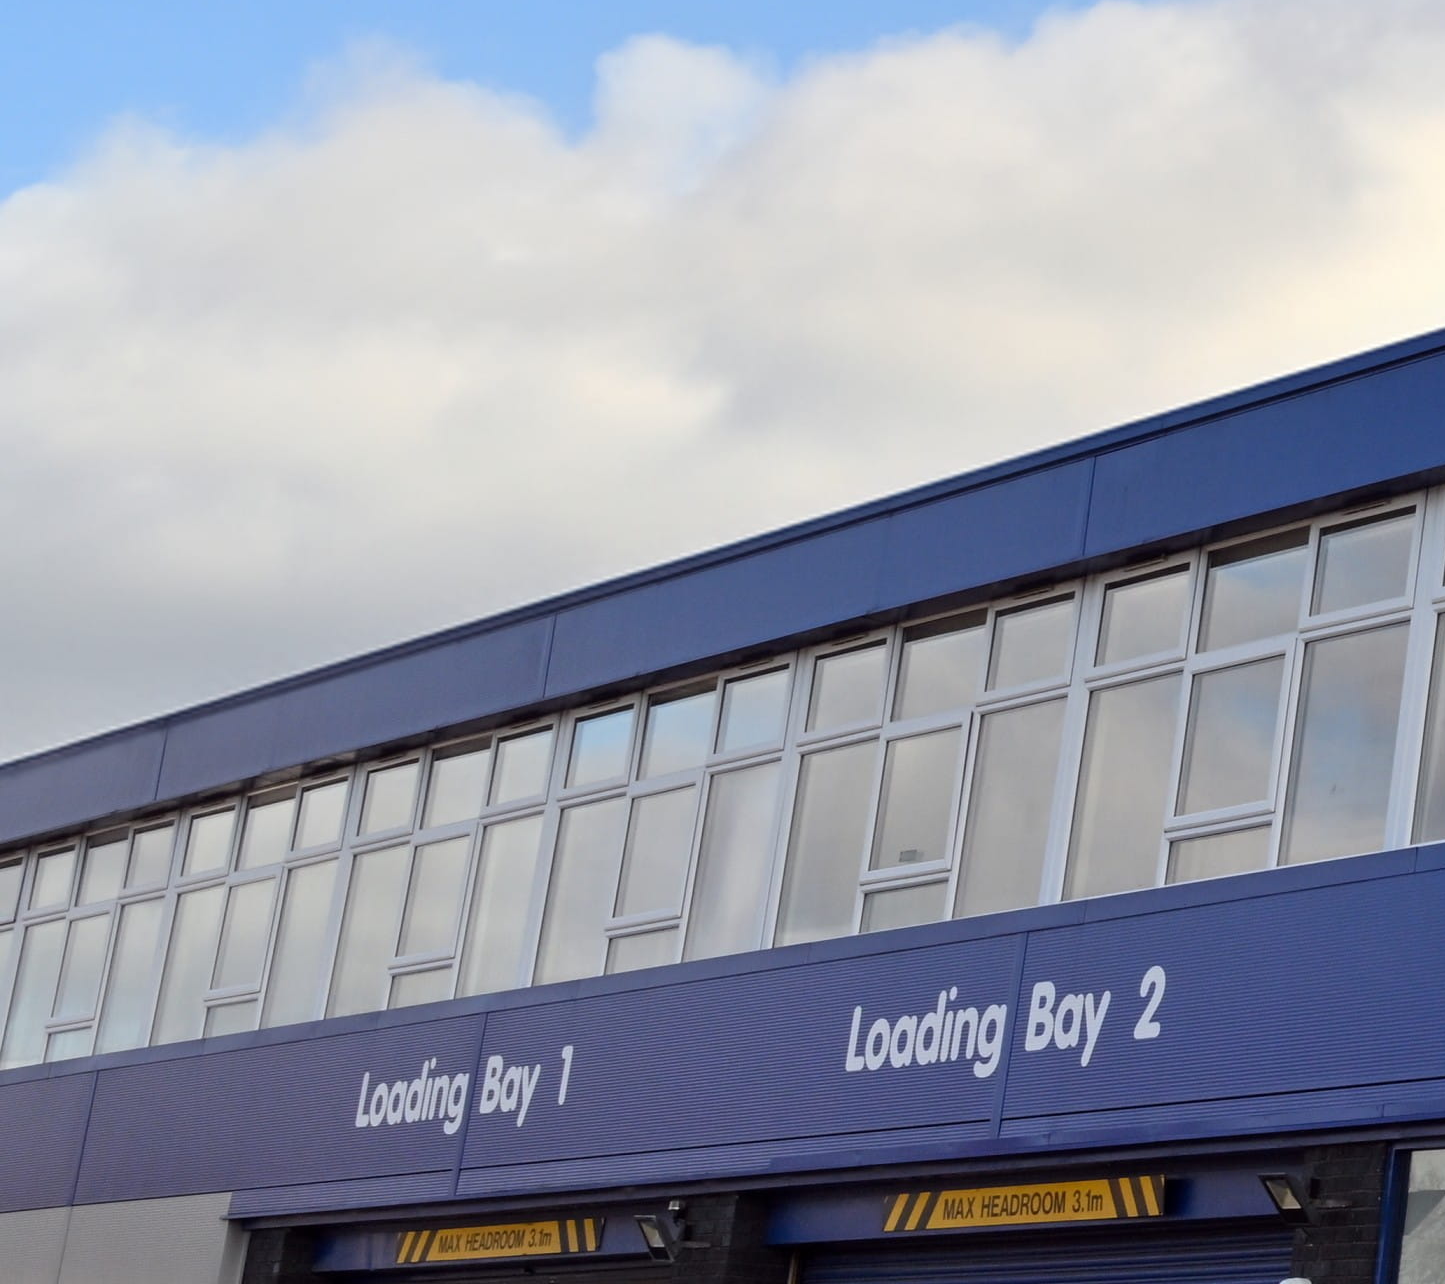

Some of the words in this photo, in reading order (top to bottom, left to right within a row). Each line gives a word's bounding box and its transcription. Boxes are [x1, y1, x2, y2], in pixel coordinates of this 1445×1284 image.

[845, 986, 1008, 1079] Loading
[1024, 981, 1112, 1067] Bay
[1133, 965, 1166, 1040] 2
[354, 1057, 470, 1135] Loading
[479, 1055, 541, 1128] Bay
[558, 1045, 574, 1106] 1
[943, 1196, 976, 1221] MAX
[980, 1190, 1066, 1218] HEADROOM
[1072, 1189, 1103, 1213] 3.1m
[438, 1234, 462, 1253] MAX
[465, 1229, 525, 1252] HEADROOM
[528, 1228, 553, 1248] 3.1m
